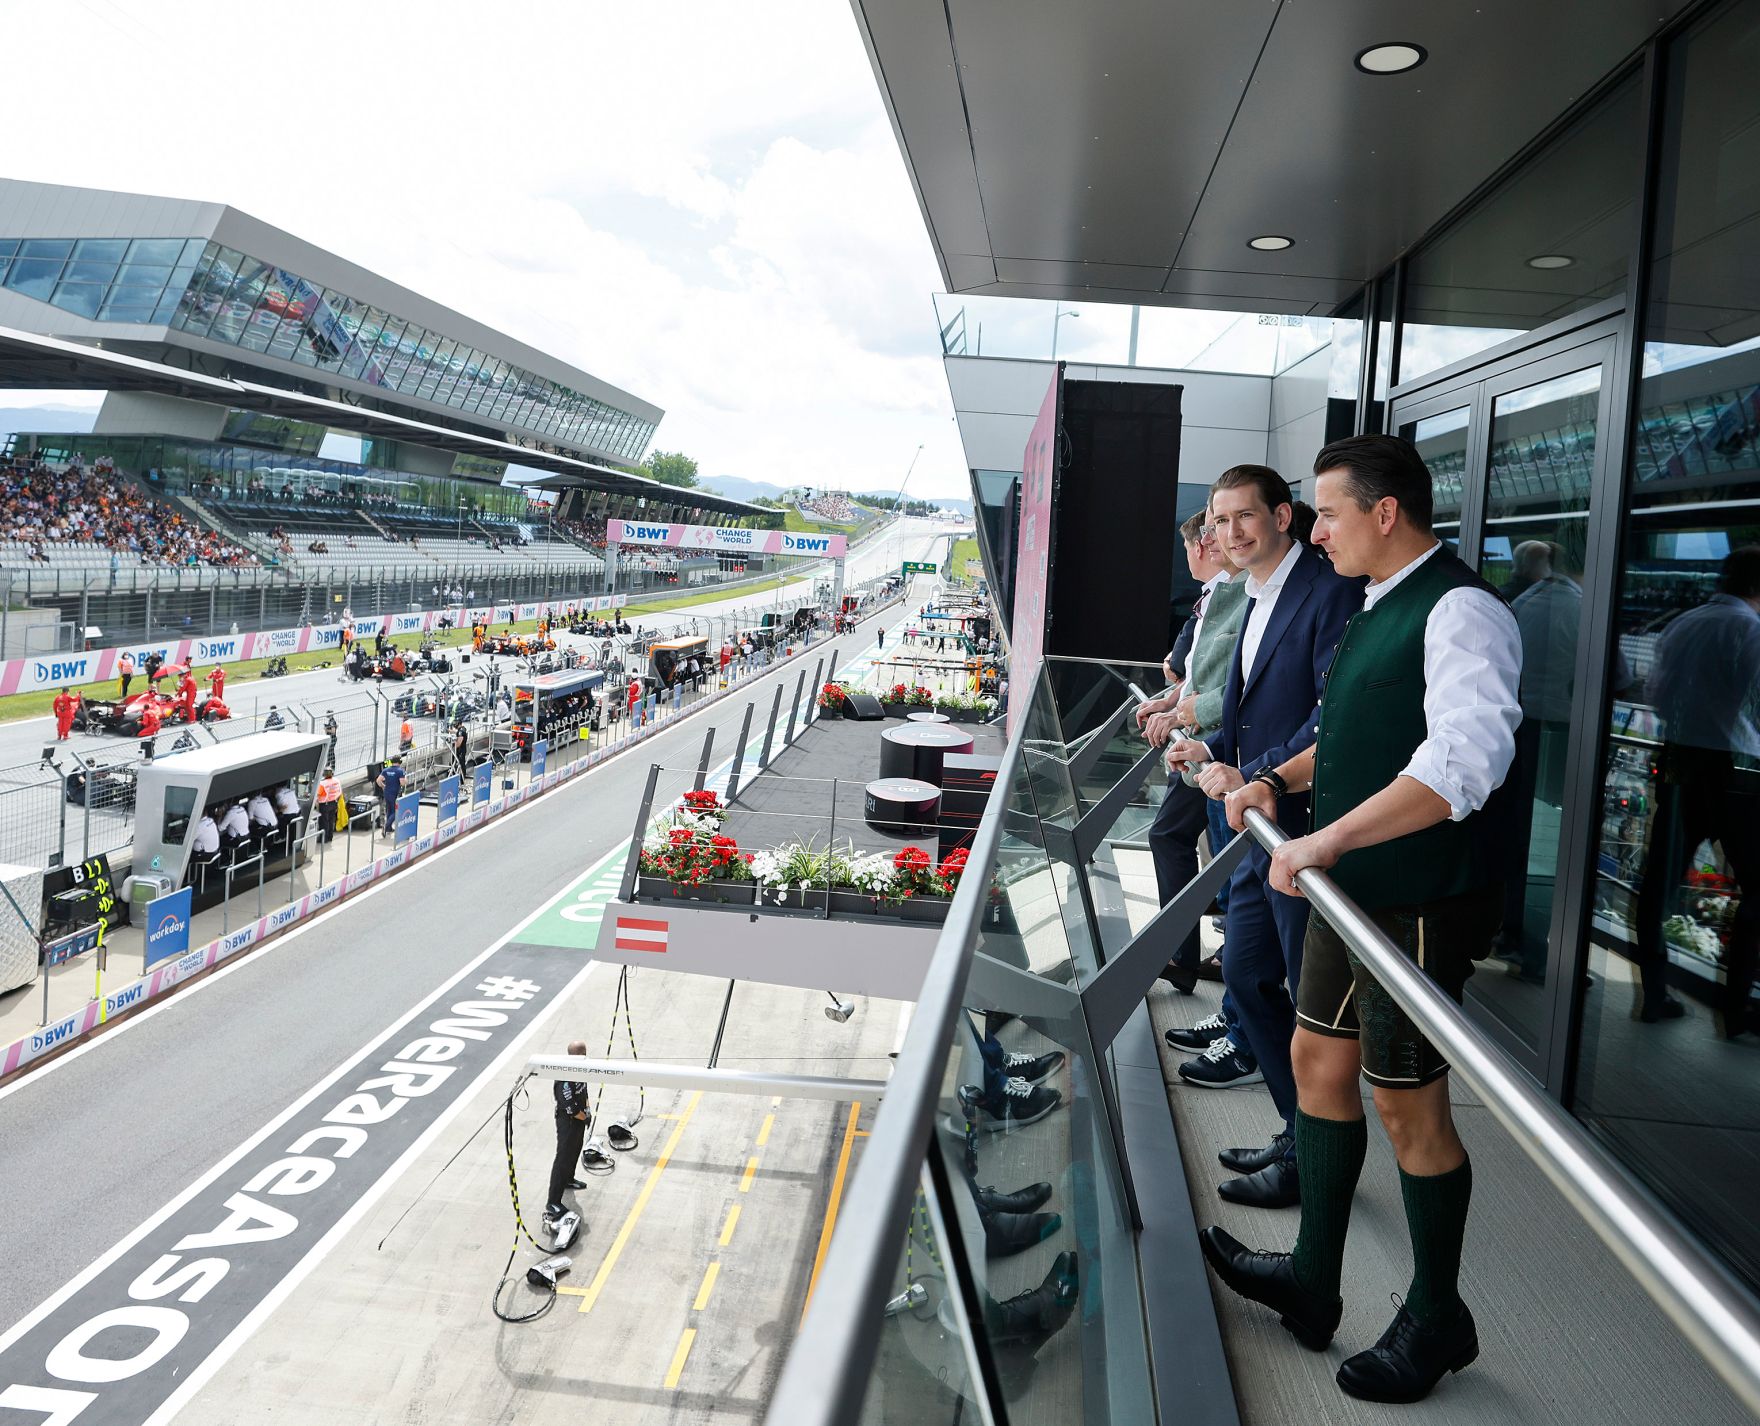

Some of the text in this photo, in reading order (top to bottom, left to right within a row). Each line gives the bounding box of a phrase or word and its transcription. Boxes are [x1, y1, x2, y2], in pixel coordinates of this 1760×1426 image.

[637, 527, 669, 540] BWT
[716, 529, 752, 538] CHANGE
[723, 537, 752, 545] WORLD
[797, 539, 830, 551] BWT
[357, 622, 377, 634] BWT
[403, 618, 420, 629] BWT
[271, 631, 296, 640] CHANGE
[209, 641, 235, 657] BWT
[276, 639, 296, 647] WORLD
[51, 659, 87, 680] BWT
[398, 815, 416, 828] workday
[446, 825, 456, 837] BWT
[419, 838, 431, 850] BWT
[389, 852, 403, 867] BWT
[73, 866, 84, 883] B
[320, 887, 336, 902] BWT
[278, 907, 296, 924] BWT
[149, 921, 185, 943] workday
[232, 930, 252, 948] BWT
[179, 950, 204, 968] CHANGE
[184, 958, 204, 972] WORLD
[117, 985, 142, 1008] BWT
[45, 1020, 75, 1046] BWT
[545, 1065, 588, 1074] MERCEDES
